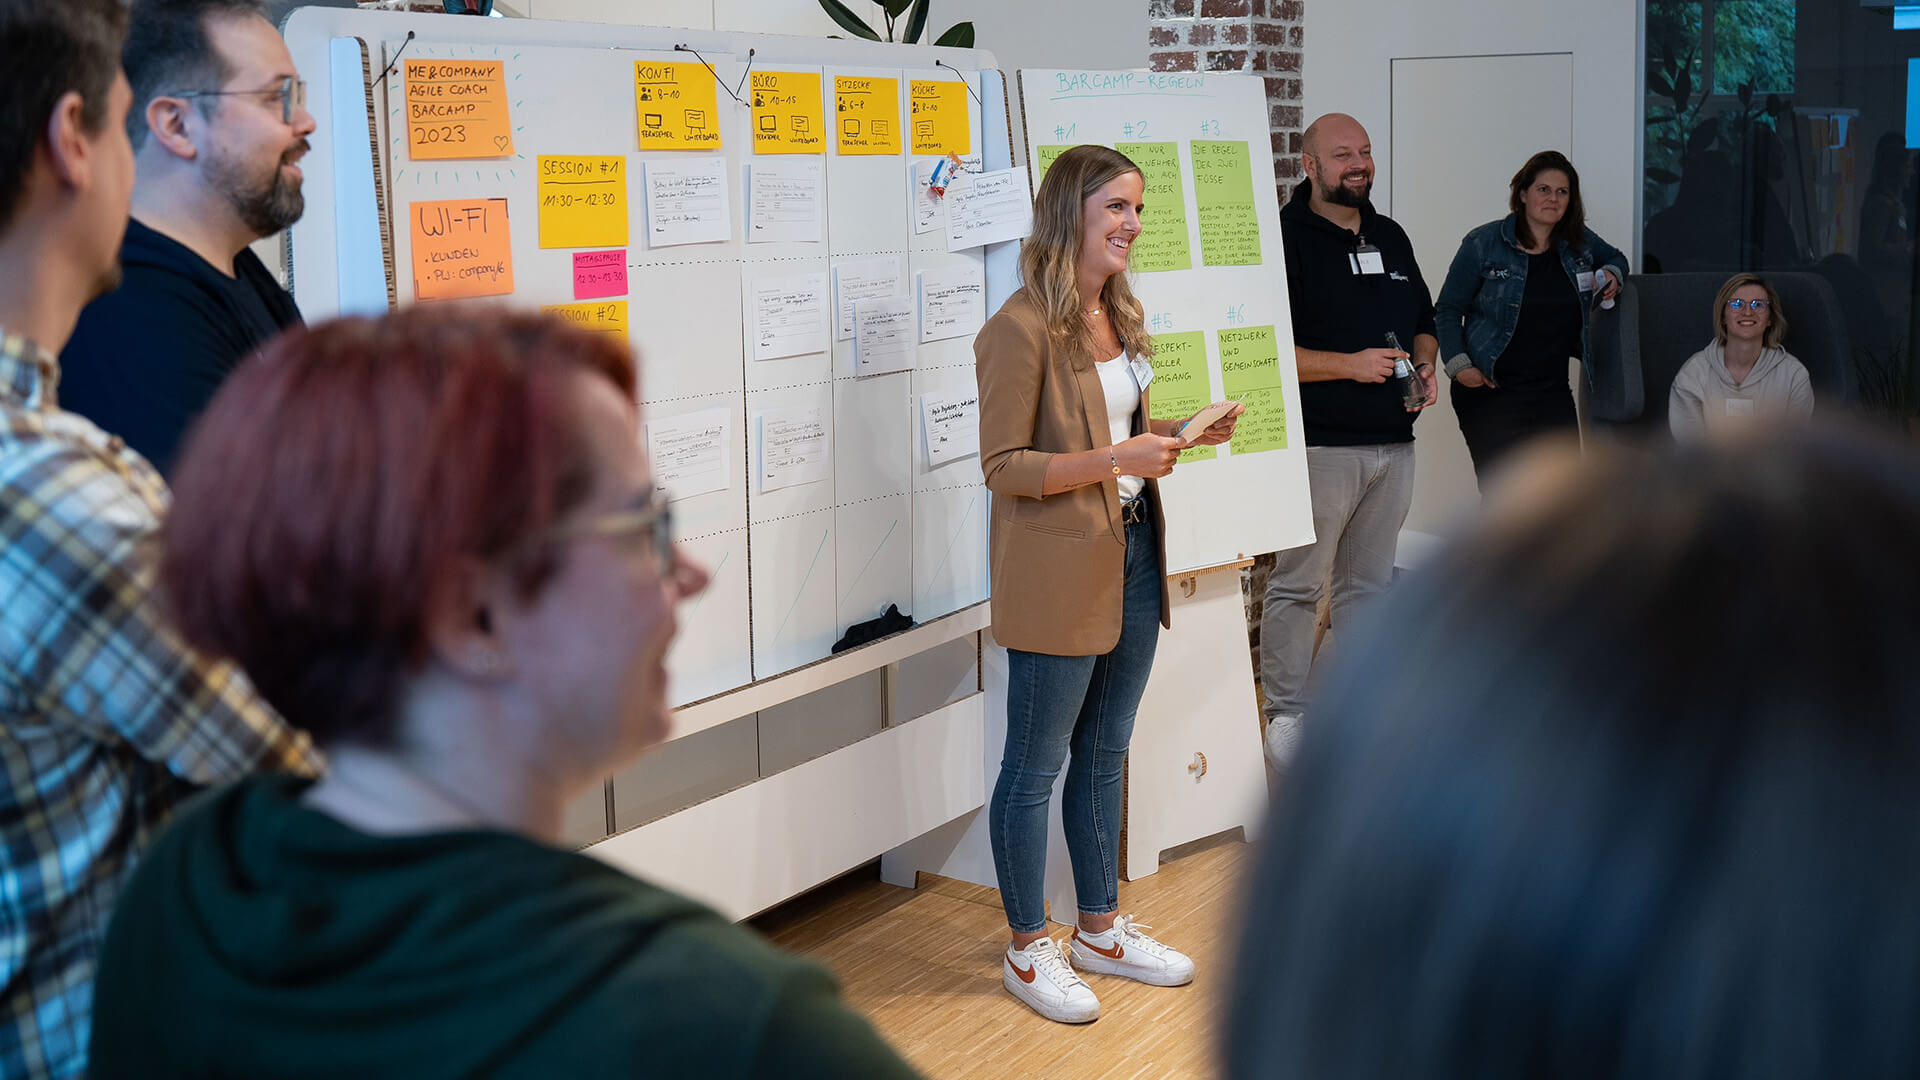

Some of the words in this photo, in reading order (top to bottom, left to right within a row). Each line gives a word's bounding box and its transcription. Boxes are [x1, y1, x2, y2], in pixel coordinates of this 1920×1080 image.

[637, 64, 675, 81] KONFI
[753, 74, 777, 88] BÜRO
[836, 79, 870, 89] SITZECKE
[409, 85, 443, 96] AGILE
[449, 84, 488, 94] COACH
[658, 88, 680, 100] 8-10
[912, 83, 935, 95] KÜCHE
[770, 95, 797, 105] 10-15
[412, 104, 476, 118] BARCAMP
[414, 124, 466, 144] 2023
[1054, 121, 1077, 141] #1
[1123, 120, 1151, 138] #2
[1200, 119, 1221, 137] #3
[1149, 145, 1165, 155] NUR
[1211, 144, 1237, 155] REGEL
[543, 160, 593, 176] SESSION
[600, 161, 619, 175] #1
[1195, 159, 1213, 169] DER
[1217, 158, 1238, 168] ZWEI
[1146, 184, 1175, 194] GEBER
[420, 207, 487, 236] WI-FI
[431, 248, 479, 263] KUNDEN
[596, 304, 620, 322] #2
[1225, 303, 1245, 326] #6
[1150, 312, 1173, 332] #5
[1220, 331, 1268, 344] NETZWERK
[1222, 348, 1240, 357] UND
[1222, 357, 1278, 373] GEMEINSCHAFT
